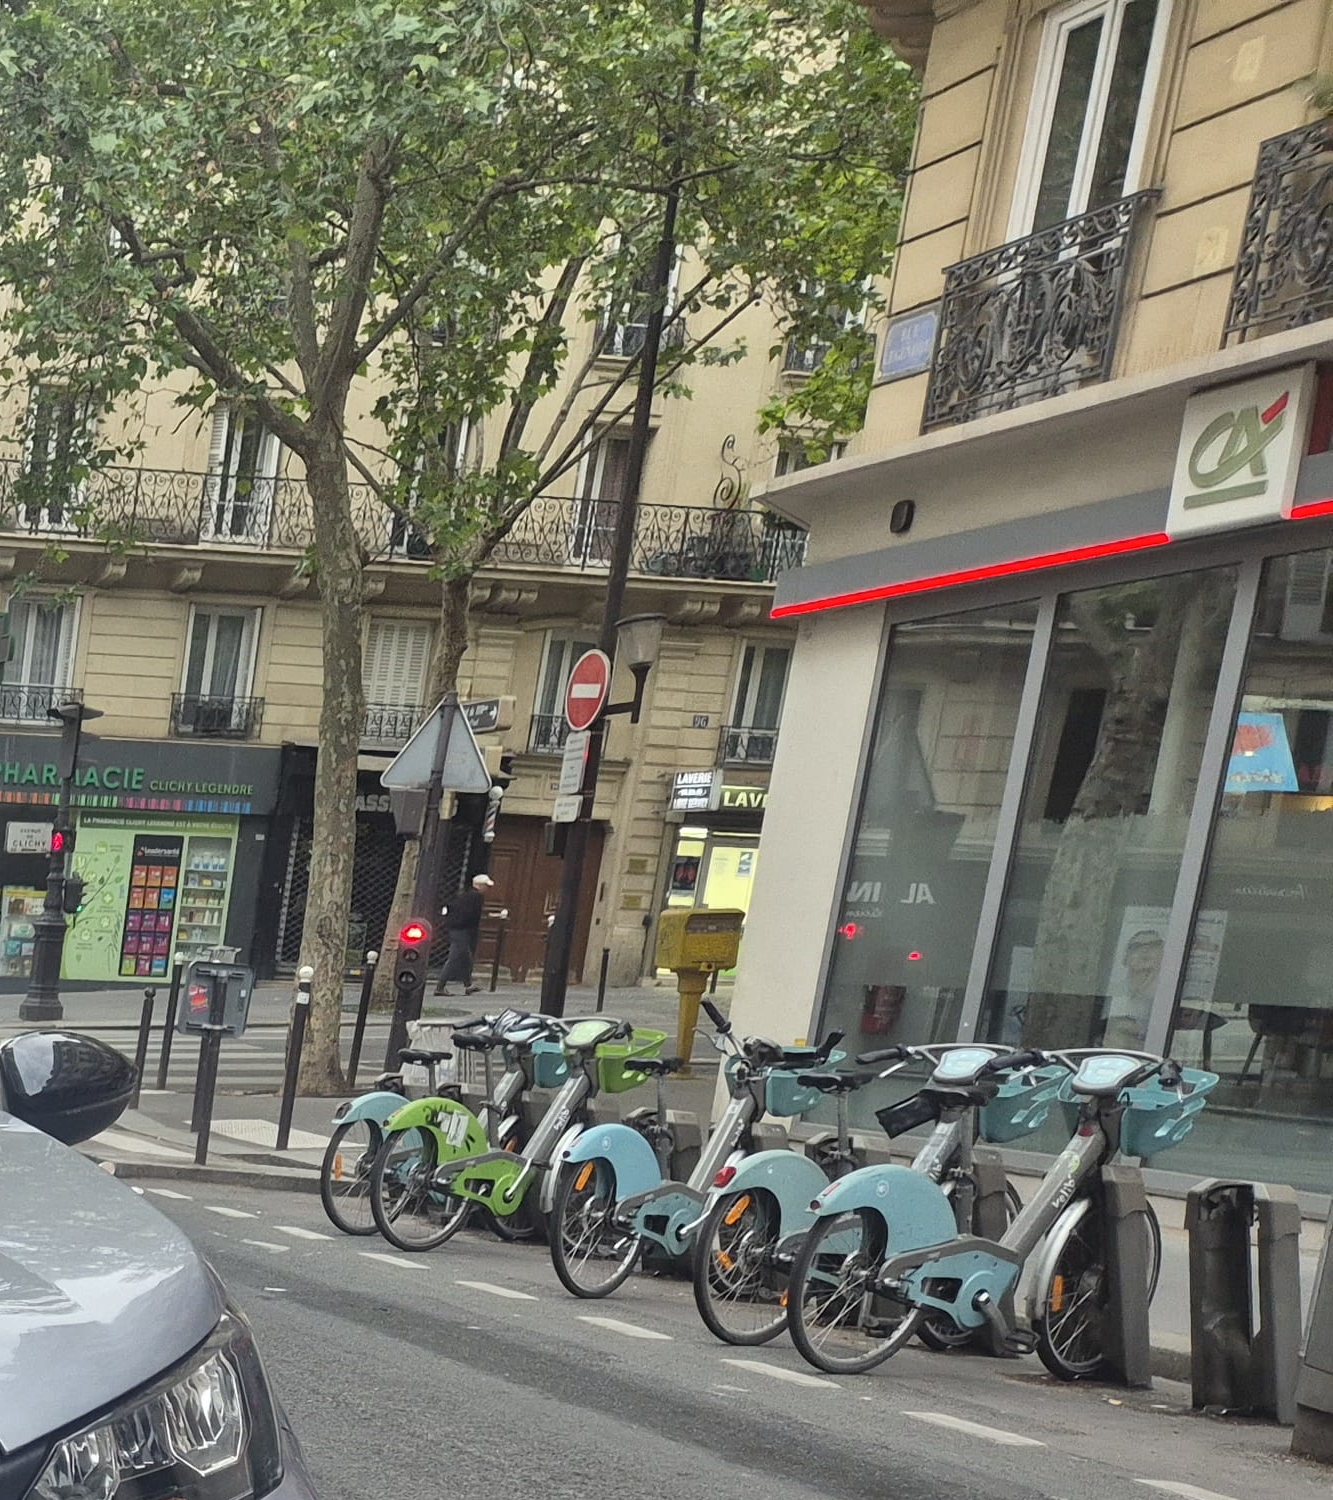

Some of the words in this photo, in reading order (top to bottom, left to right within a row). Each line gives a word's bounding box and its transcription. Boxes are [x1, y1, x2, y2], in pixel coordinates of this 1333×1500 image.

[677, 772, 712, 785] LAVERIE
[149, 779, 193, 793] CLICHY
[194, 781, 255, 796] LEGENDRE
[355, 794, 393, 812] ASS
[12, 839, 46, 847] CLICHY
